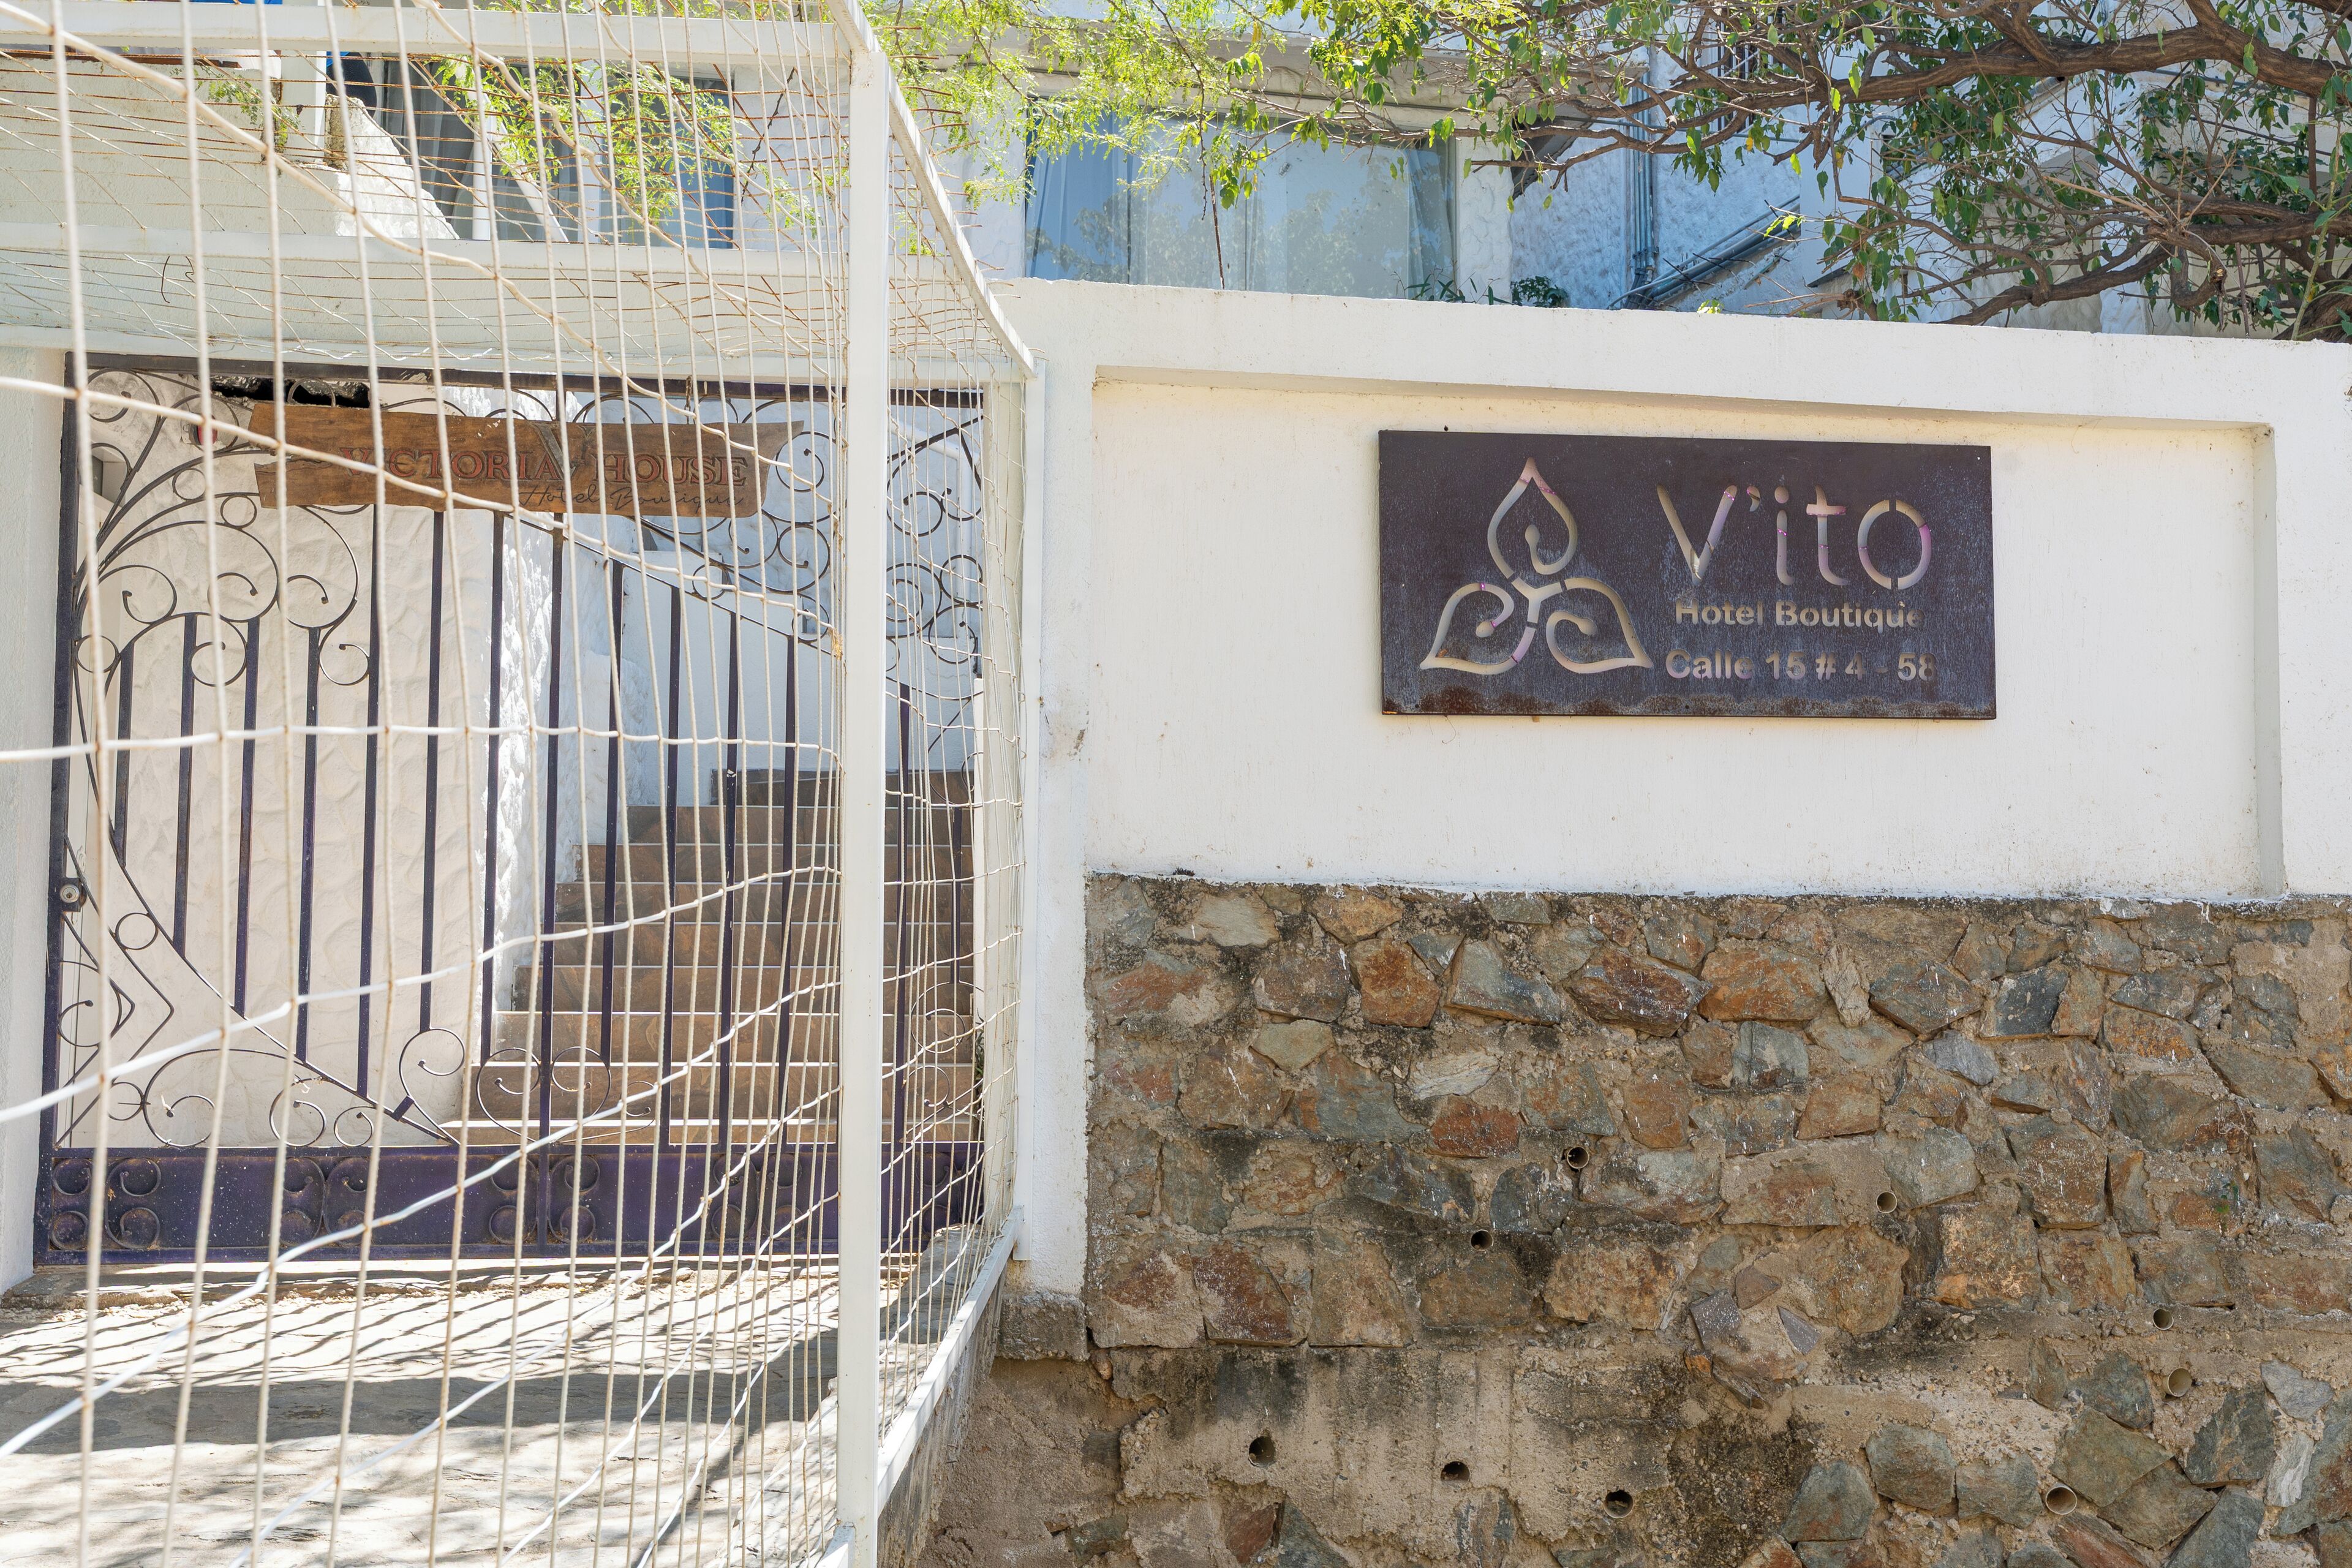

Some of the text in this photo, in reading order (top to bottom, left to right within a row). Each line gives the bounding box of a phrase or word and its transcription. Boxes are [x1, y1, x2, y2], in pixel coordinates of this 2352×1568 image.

[341, 447, 748, 486] VCTORIA HOUSE
[517, 483, 600, 507] Hotel
[1675, 597, 1926, 633] Hotel Boutique
[1665, 649, 1755, 680] Calle
[1766, 651, 1806, 679] 15
[1815, 651, 1837, 680] #
[1845, 652, 1866, 680] 4
[1898, 652, 1938, 681] 58
